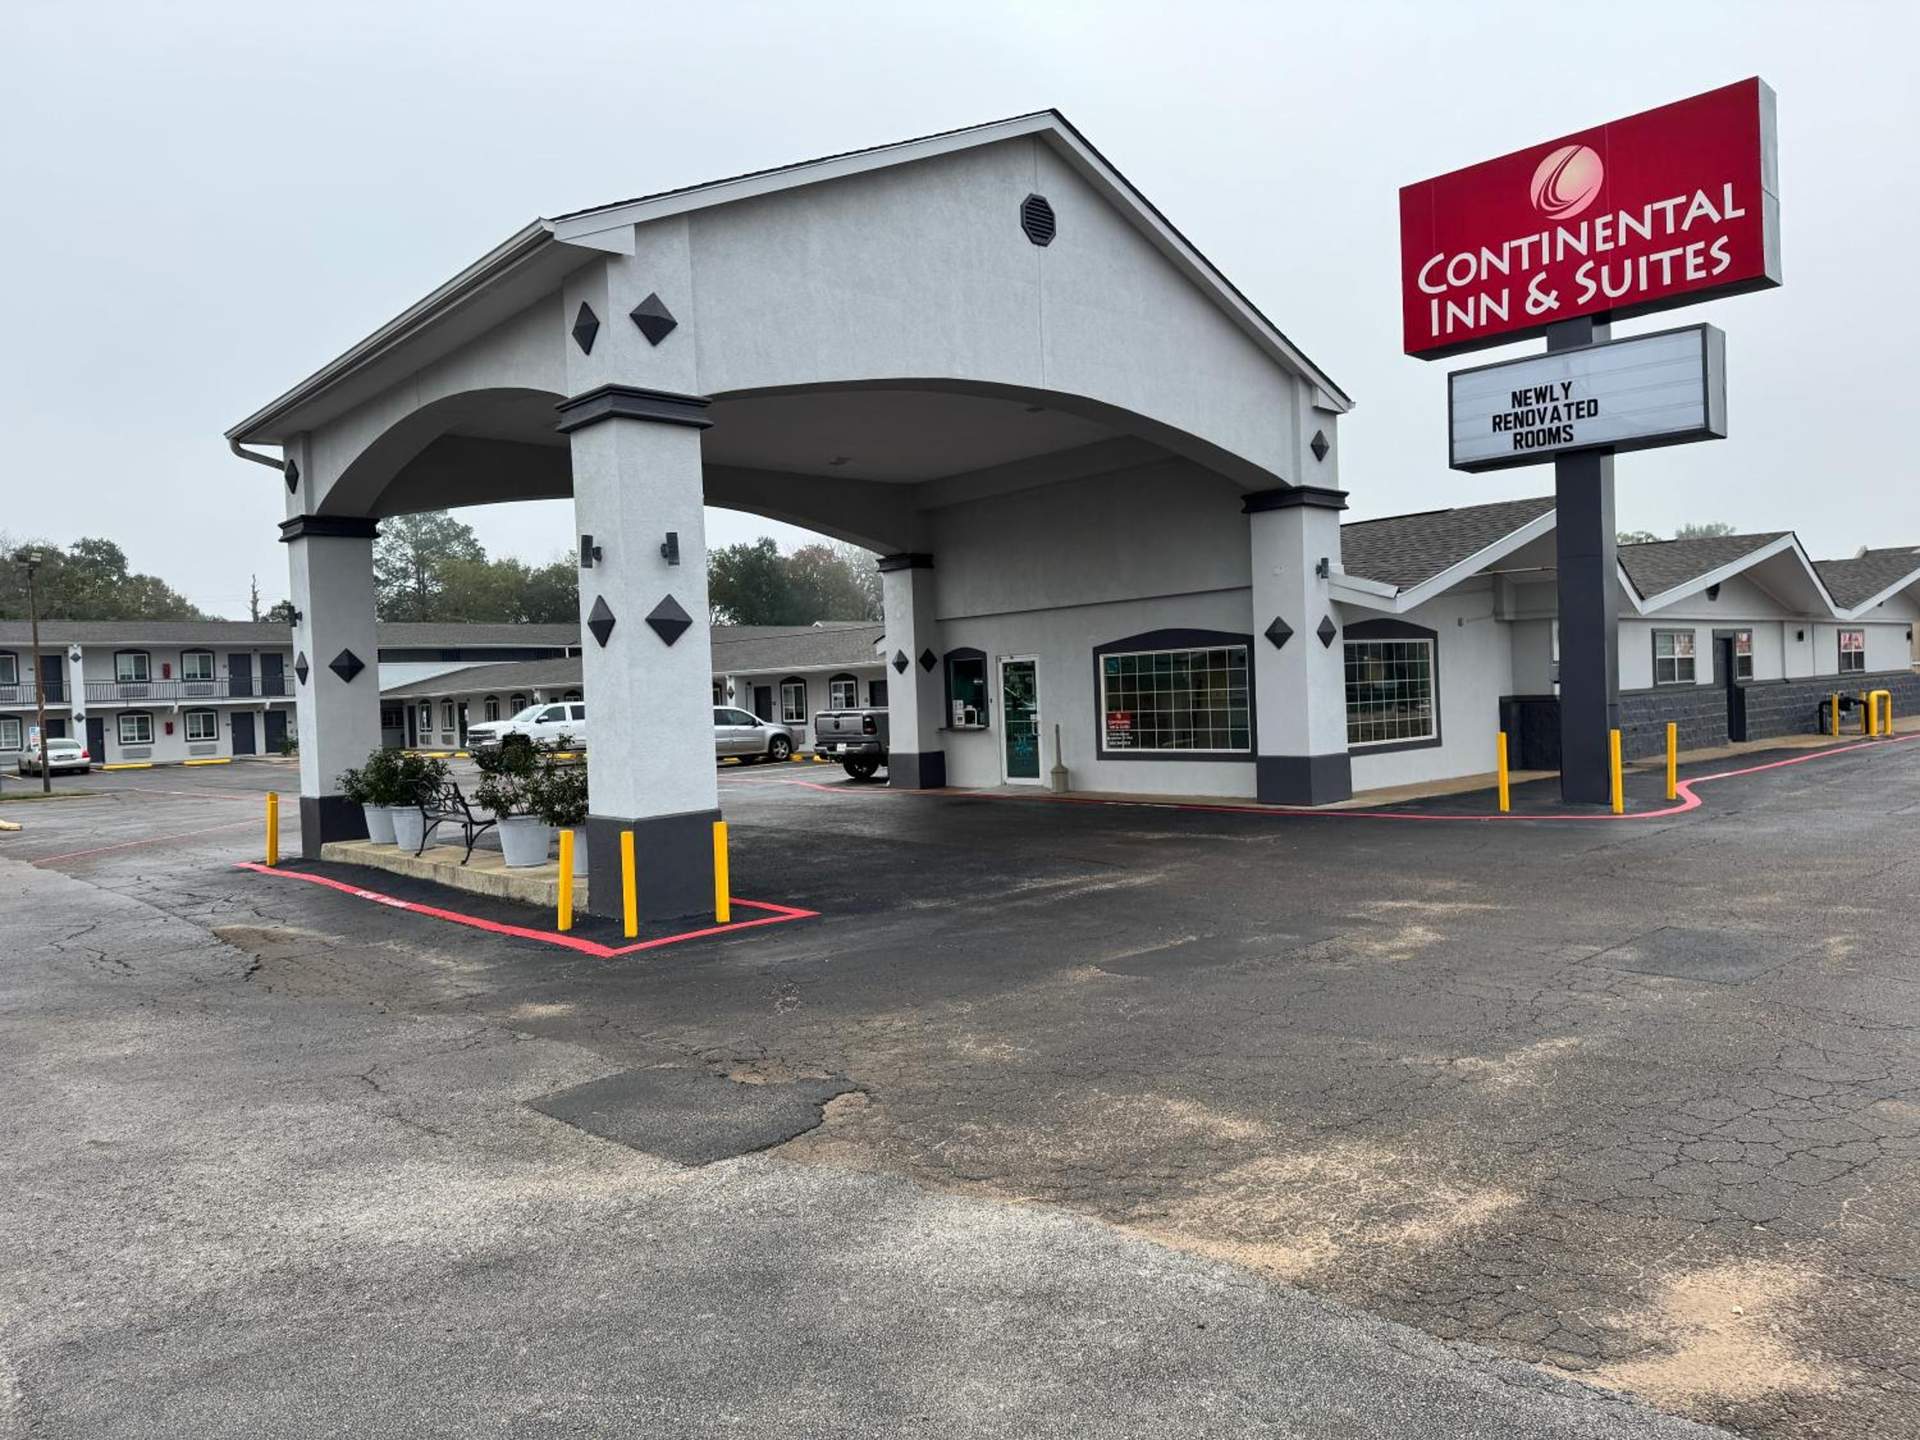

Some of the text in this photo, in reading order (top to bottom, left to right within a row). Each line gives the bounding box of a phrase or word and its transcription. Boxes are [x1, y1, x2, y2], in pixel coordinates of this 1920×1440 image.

[1417, 182, 1745, 294] CONTINENTAL
[1430, 235, 1731, 337] INN & SUITES
[1511, 381, 1573, 409] NEWLY
[1492, 398, 1599, 433] RENOVATED
[1513, 424, 1574, 451] ROOMS
